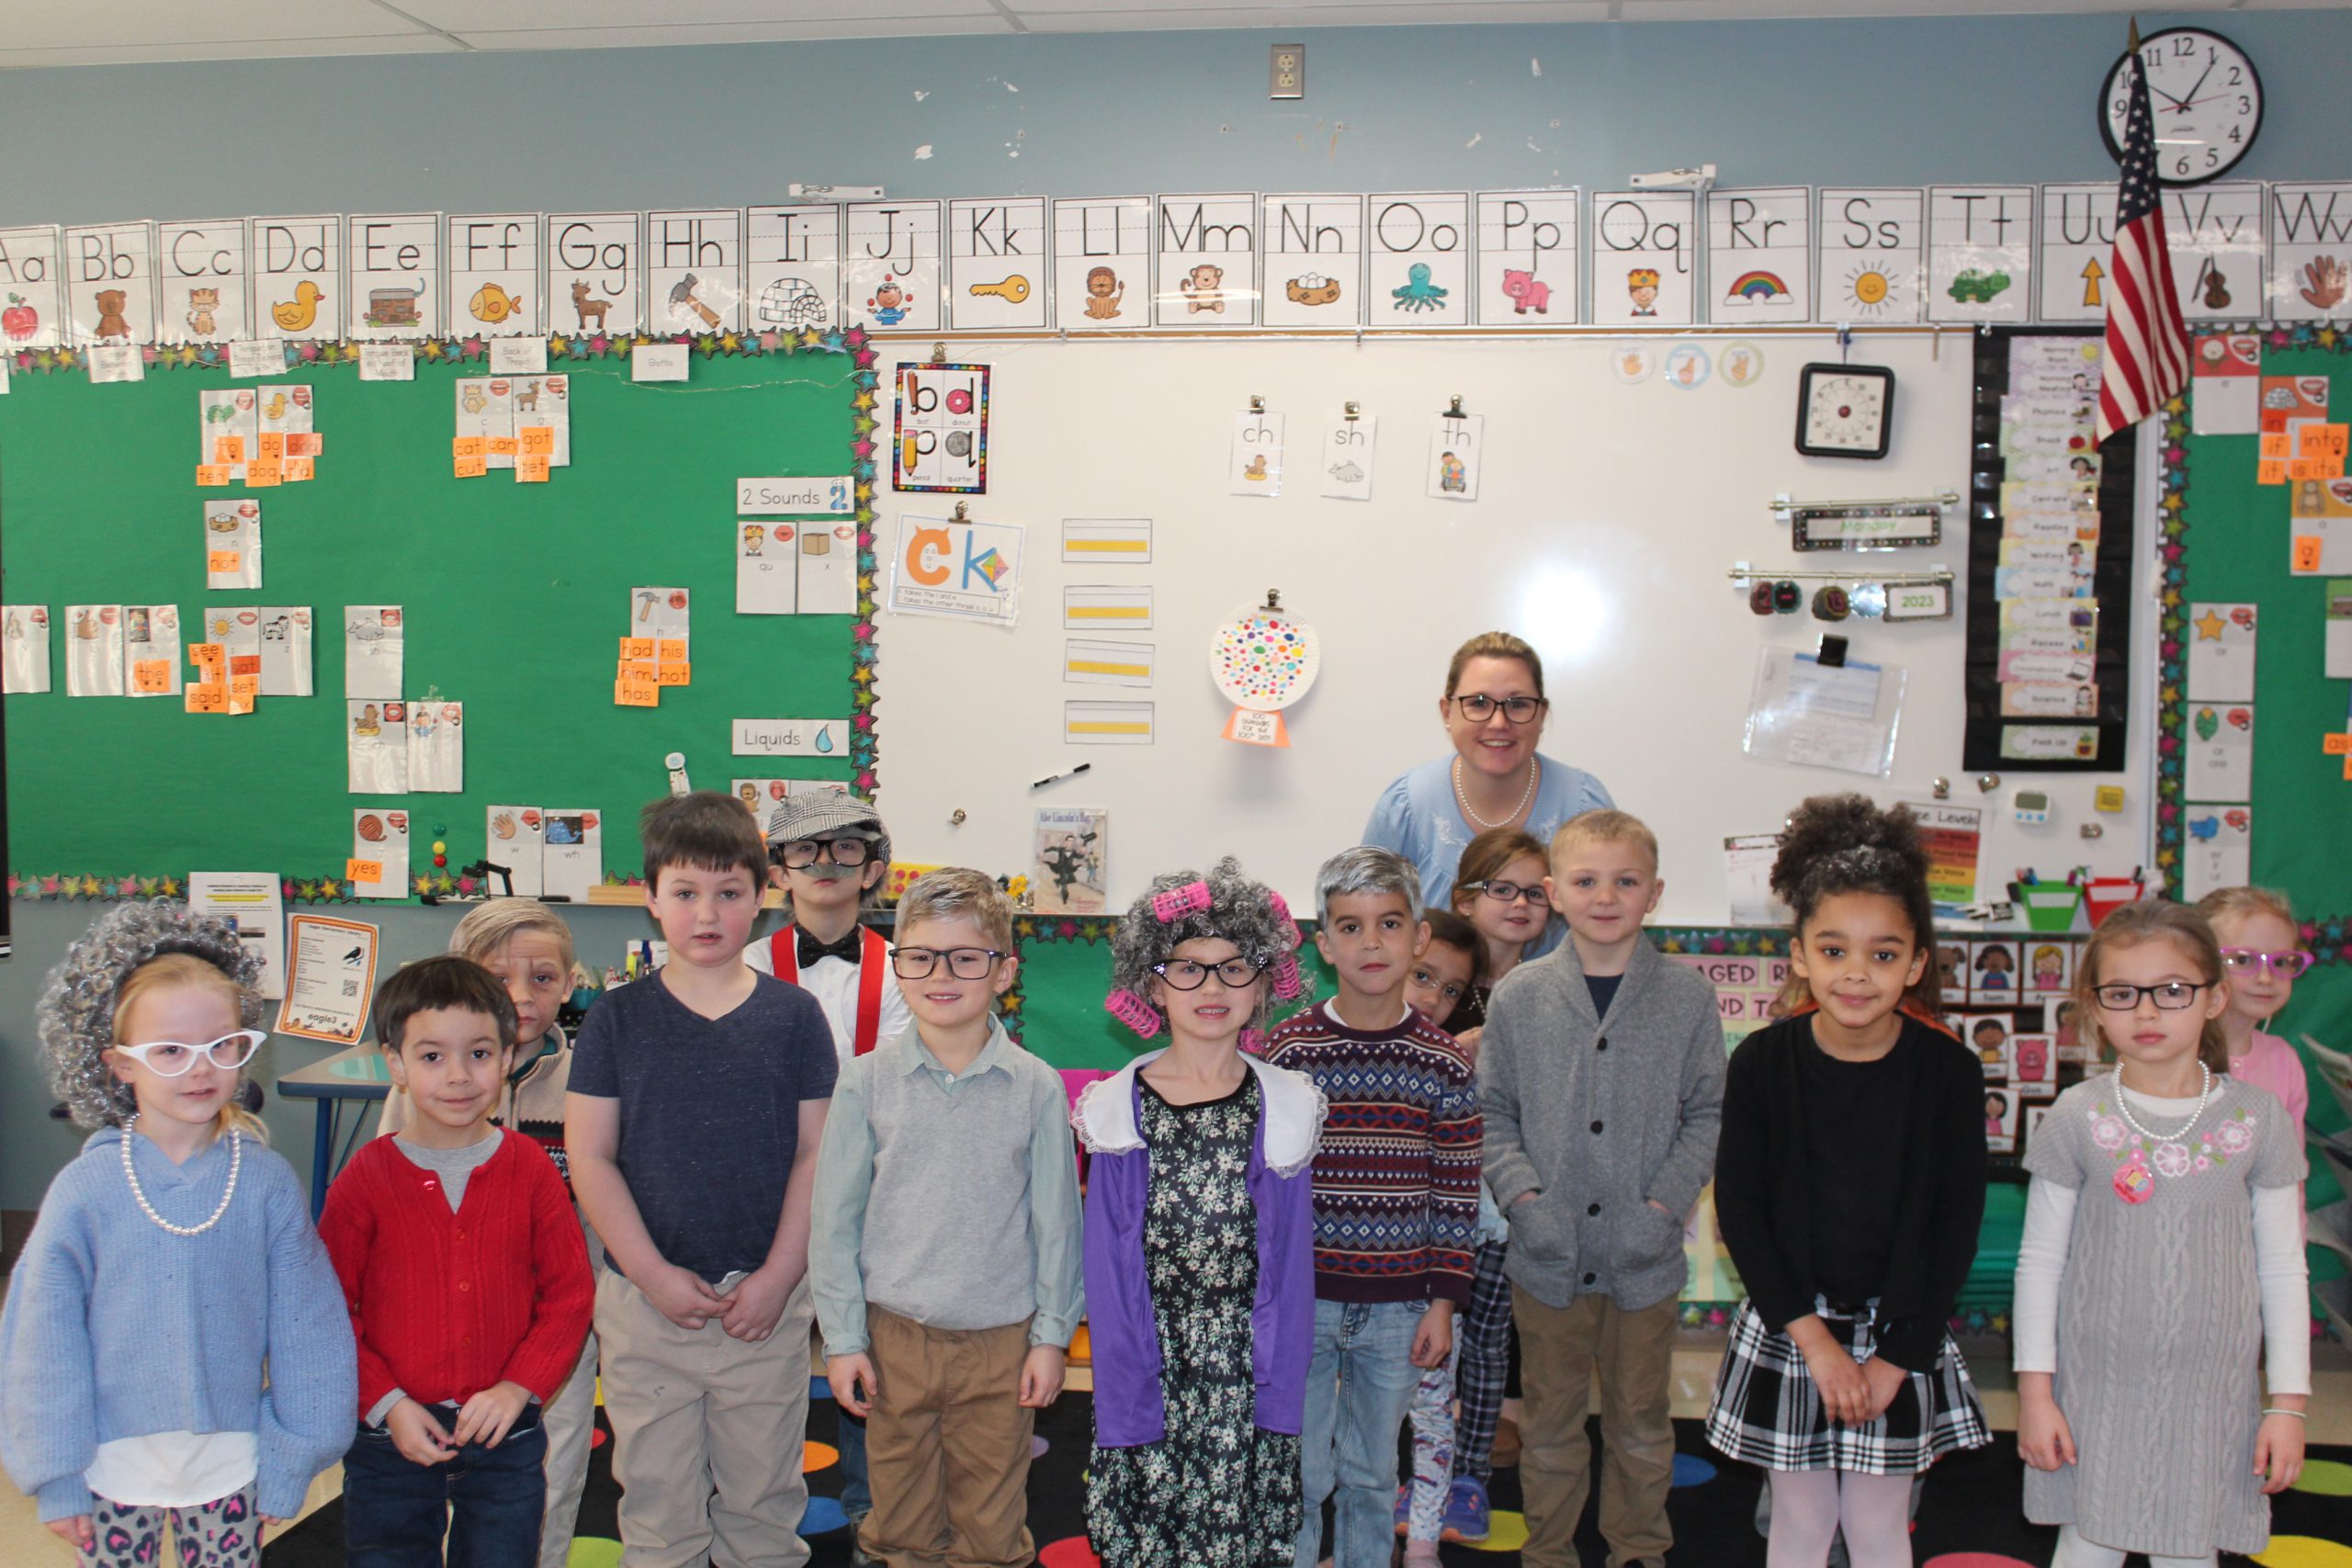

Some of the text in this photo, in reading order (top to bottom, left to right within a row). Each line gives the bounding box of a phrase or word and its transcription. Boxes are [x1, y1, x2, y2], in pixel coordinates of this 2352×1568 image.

[2146, 48, 2163, 67] 11
[2172, 38, 2196, 57] 12
[2228, 67, 2243, 86] 2
[2115, 99, 2128, 119] 9
[2238, 96, 2251, 116] 3
[2228, 125, 2242, 143] 4
[2176, 155, 2190, 175] 6
[2206, 148, 2220, 168] 5
[1161, 203, 1253, 253] Mm
[1282, 203, 1343, 254] Nn
[1377, 202, 1459, 253] Oo
[1730, 197, 1787, 250] Rr
[1844, 197, 1901, 250] Ss
[1951, 196, 2013, 246] Tt
[2178, 192, 2245, 245] Vv
[775, 213, 810, 263] Ii
[972, 208, 1023, 256] Kk
[1083, 206, 1120, 256] Ll
[1504, 200, 1561, 273] Pp
[1600, 200, 1689, 275] Qq
[266, 224, 326, 273] Dd
[367, 223, 421, 272] Ee
[468, 223, 521, 272] Ff
[663, 220, 724, 268] Hh
[865, 209, 914, 276] Jj
[83, 235, 135, 281] Bb
[172, 231, 232, 276] Cc
[558, 223, 627, 296] Gg
[502, 346, 521, 355] Back
[1242, 418, 1273, 445] ch
[2267, 415, 2282, 429] in
[262, 434, 280, 451] do
[523, 427, 551, 454] got
[1336, 420, 1364, 446] sh
[1442, 419, 1471, 446] th
[2303, 432, 2344, 450] into
[455, 437, 481, 455] cat
[488, 440, 516, 450] can
[2267, 435, 2285, 454] if
[198, 466, 226, 482] ten
[248, 460, 277, 485] dog
[456, 457, 483, 476] cut
[2265, 460, 2278, 478] it
[2292, 461, 2307, 476] is
[2313, 458, 2338, 476] its
[742, 489, 752, 505] 2
[760, 488, 821, 505] Sounds
[1840, 519, 1898, 534] Monday
[209, 555, 239, 570] not
[759, 563, 774, 571] qu
[1902, 594, 1935, 609] 2023
[192, 645, 220, 657] see
[621, 638, 653, 658] had
[660, 639, 684, 658] his
[138, 660, 164, 681] the
[232, 656, 257, 673] sat
[659, 662, 688, 683] hot
[232, 676, 255, 694] set
[621, 683, 651, 701] has
[189, 686, 221, 705] said
[743, 728, 801, 750] Liquids
[563, 849, 581, 859] wh
[351, 862, 379, 877] yes
[1698, 964, 1757, 984] GED
[308, 1013, 337, 1023] eagle3
